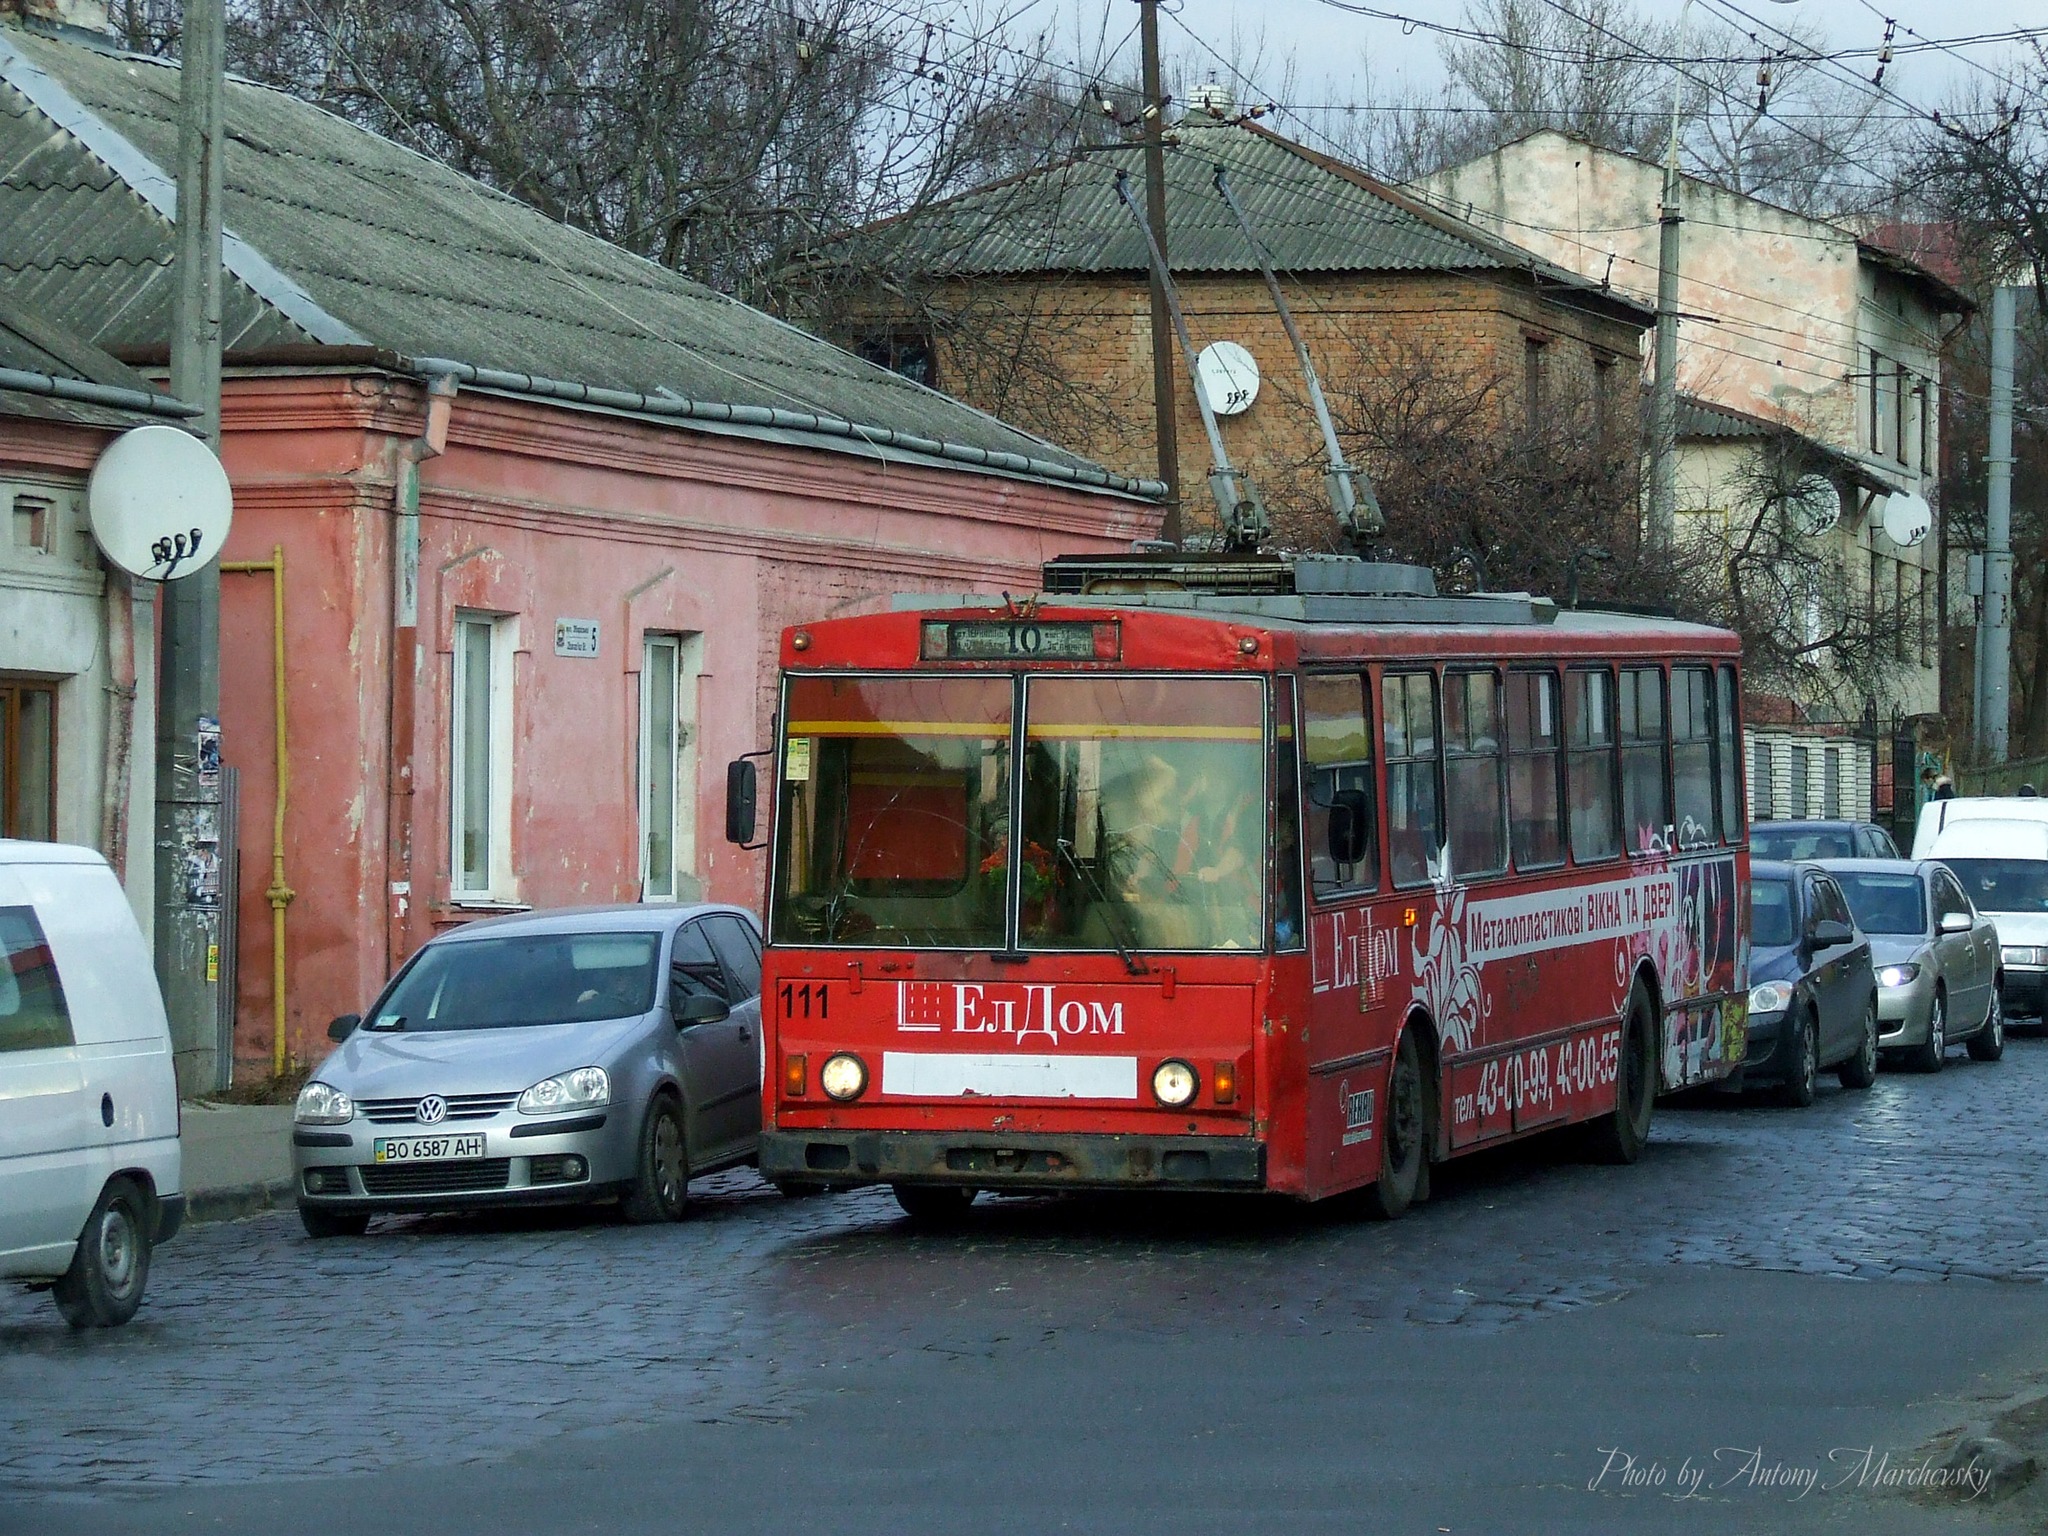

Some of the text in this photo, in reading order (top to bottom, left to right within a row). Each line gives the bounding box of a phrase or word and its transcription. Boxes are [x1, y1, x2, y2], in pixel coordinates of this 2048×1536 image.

[591, 627, 597, 651] 5
[1007, 625, 1042, 654] 10
[1471, 881, 1675, 953] Металопластикові ВІКНА ТА ДВЕРІ
[1332, 907, 1400, 1000] ЕлДом
[780, 983, 829, 1019] 111
[952, 984, 1126, 1045] ЕлДом
[1455, 1093, 1475, 1124] тел.
[413, 1139, 449, 1157] 6587
